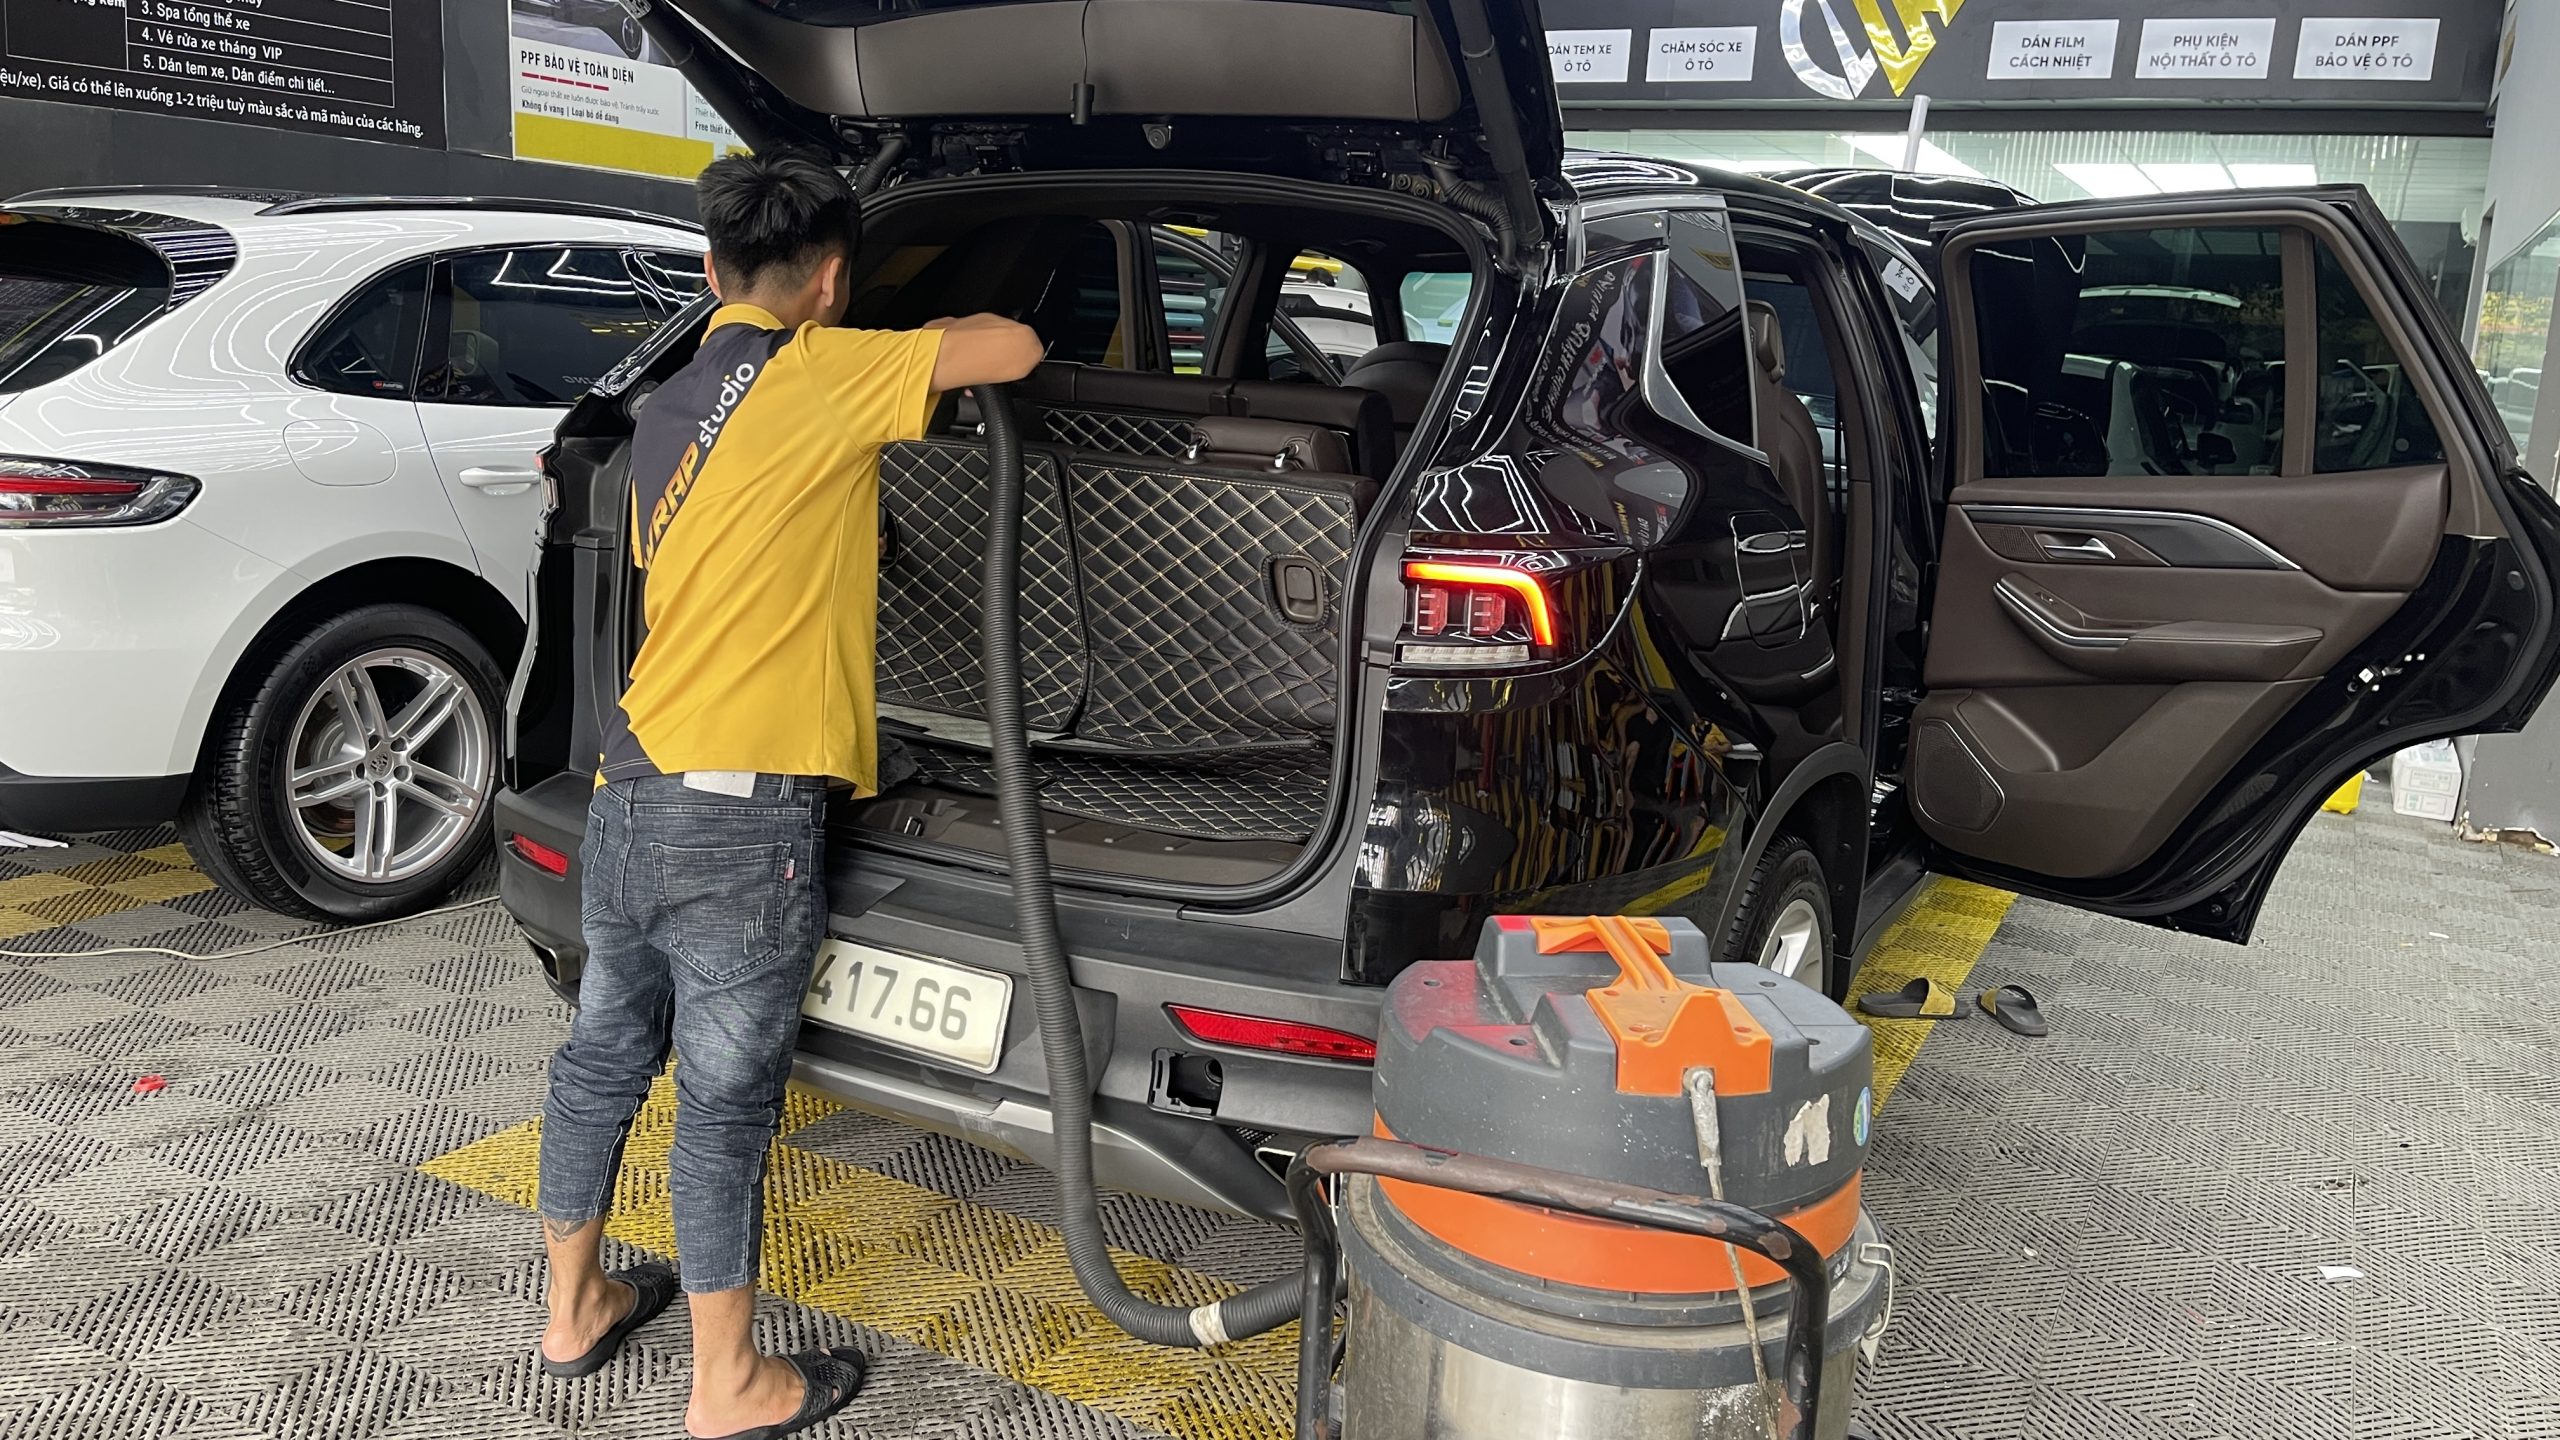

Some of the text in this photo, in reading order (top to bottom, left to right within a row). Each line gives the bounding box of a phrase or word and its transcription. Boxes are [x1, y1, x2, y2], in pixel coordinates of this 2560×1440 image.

[156, 2, 181, 21] Spa
[183, 6, 211, 28] tổng
[213, 12, 233, 28] thể
[235, 19, 251, 31] xe
[141, 26, 283, 60] 4. Vé rửa xe tháng VIP
[1661, 40, 1743, 54] CHĂM SÓC XE
[2021, 36, 2085, 48] DÁN FILM
[2173, 34, 2239, 50] PHỤ KIỆN
[2335, 32, 2400, 47] DÁN PPF
[1574, 45, 1596, 55] TEM
[1598, 45, 1613, 54] XE
[2150, 50, 2257, 68] NỘI THẤT Ô TÔ
[521, 50, 635, 85] PPF BẢO VỆ TOÀN DIỆN
[1564, 60, 1592, 72] Ô TÔ
[1685, 58, 1714, 71] Ô TÔ
[2009, 55, 2092, 71] CÁCH NHIỆT
[2315, 51, 2413, 71] BẢO VỆ Ô TÔ
[143, 54, 155, 69] 5.
[158, 56, 183, 73] Dán
[185, 60, 208, 77] tem
[211, 66, 229, 81] xe,
[232, 66, 255, 83] Dán
[257, 70, 285, 88] điểm
[288, 75, 305, 90] chi
[48, 75, 70, 91] Giá
[72, 77, 88, 93] có
[90, 80, 112, 96] thể
[114, 82, 133, 99] lên
[135, 86, 174, 108] xuống
[175, 91, 195, 107] 1-2
[196, 93, 224, 112] triệu
[247, 99, 273, 114] màu
[275, 102, 294, 119] sắc
[295, 105, 309, 120] và
[310, 108, 328, 123] mã
[330, 110, 354, 126] màu
[355, 113, 375, 129] của
[376, 116, 394, 131] các
[395, 119, 424, 139] hãng.
[698, 362, 756, 448] studio
[809, 953, 973, 1041] 417.66
